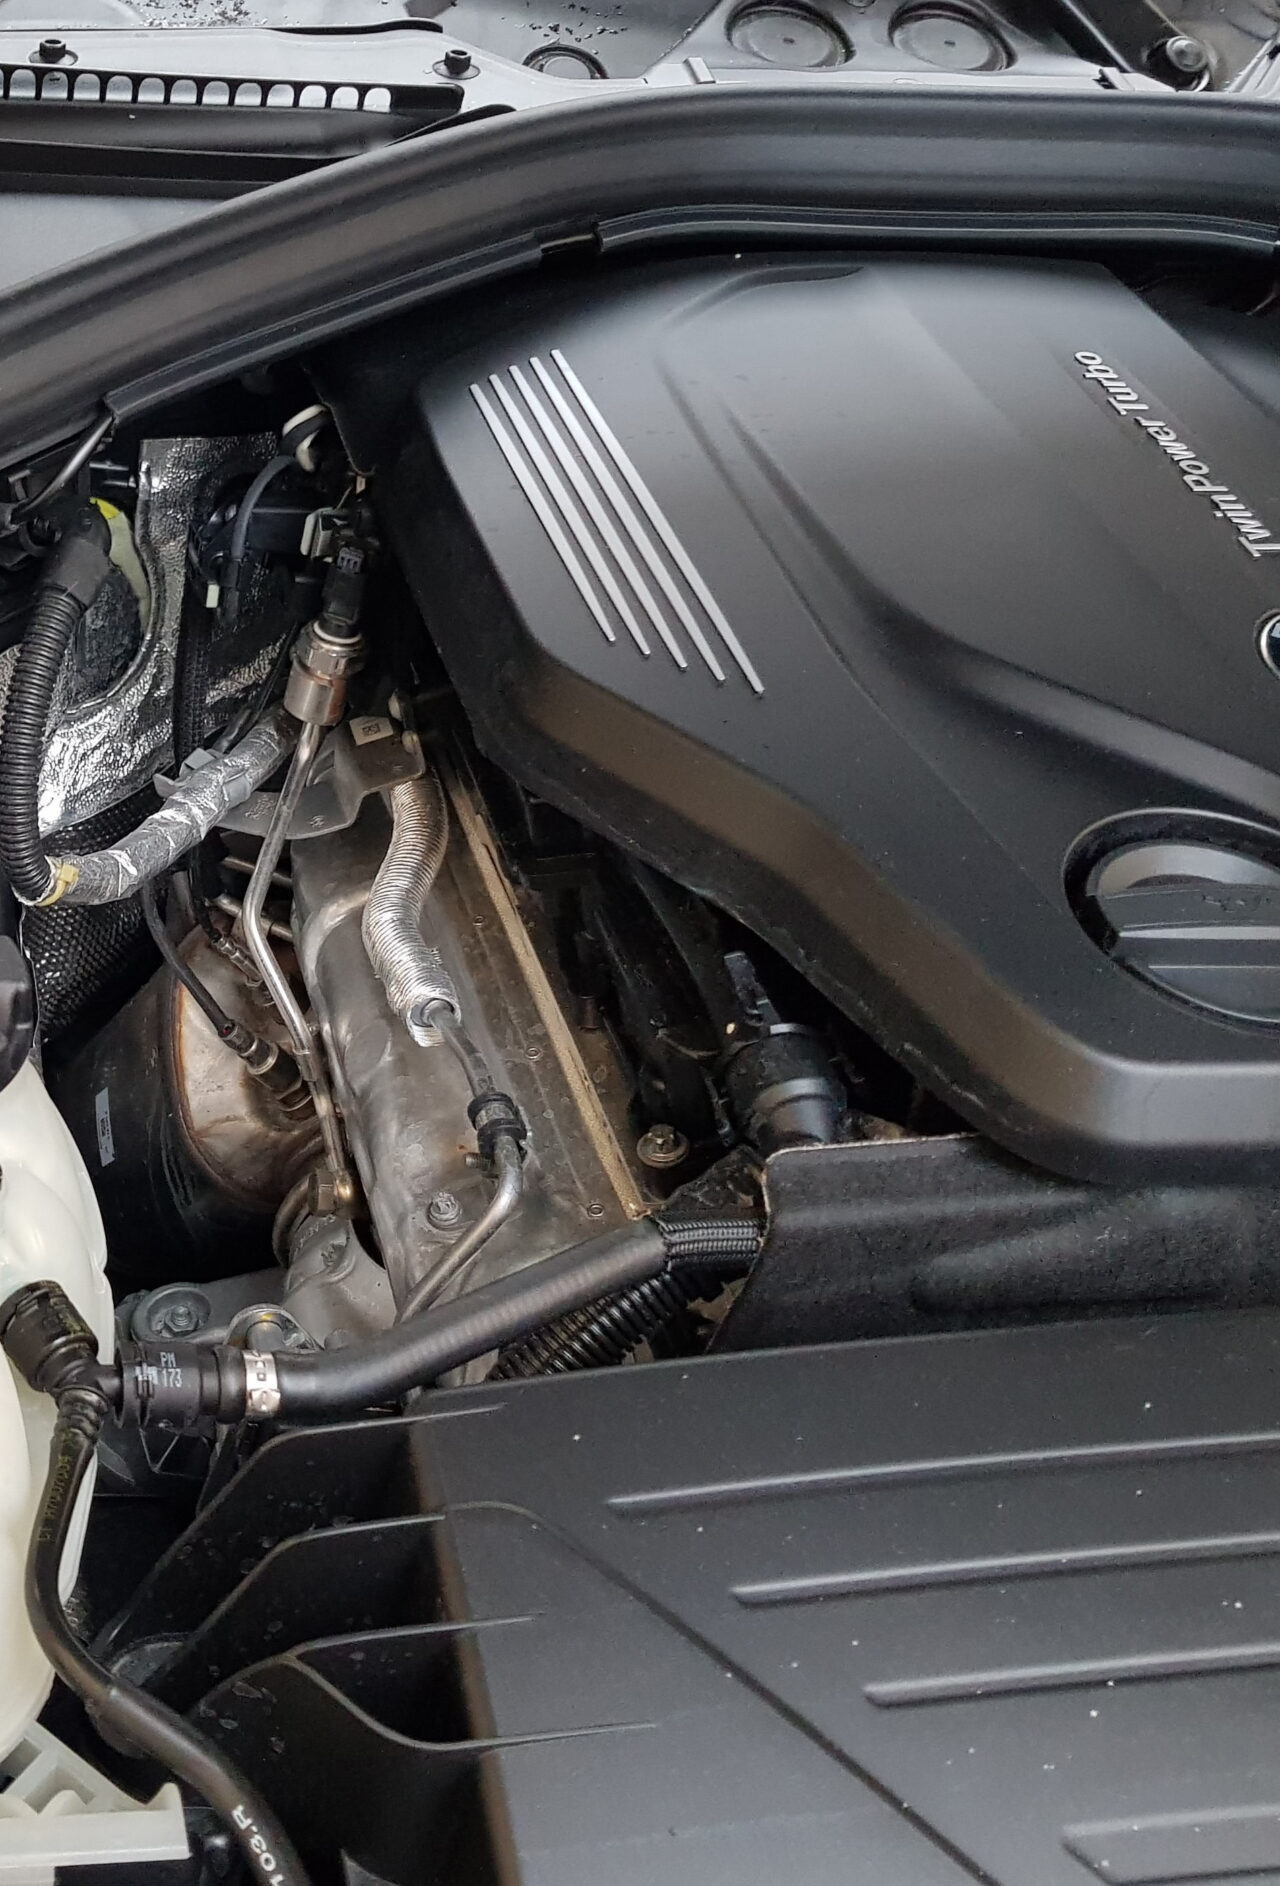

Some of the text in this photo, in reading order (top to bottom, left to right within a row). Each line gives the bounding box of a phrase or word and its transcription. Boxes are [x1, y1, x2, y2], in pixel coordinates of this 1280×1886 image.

[1074, 350, 1280, 558] TwinPower Turbo
[161, 1367, 182, 1388] 173
